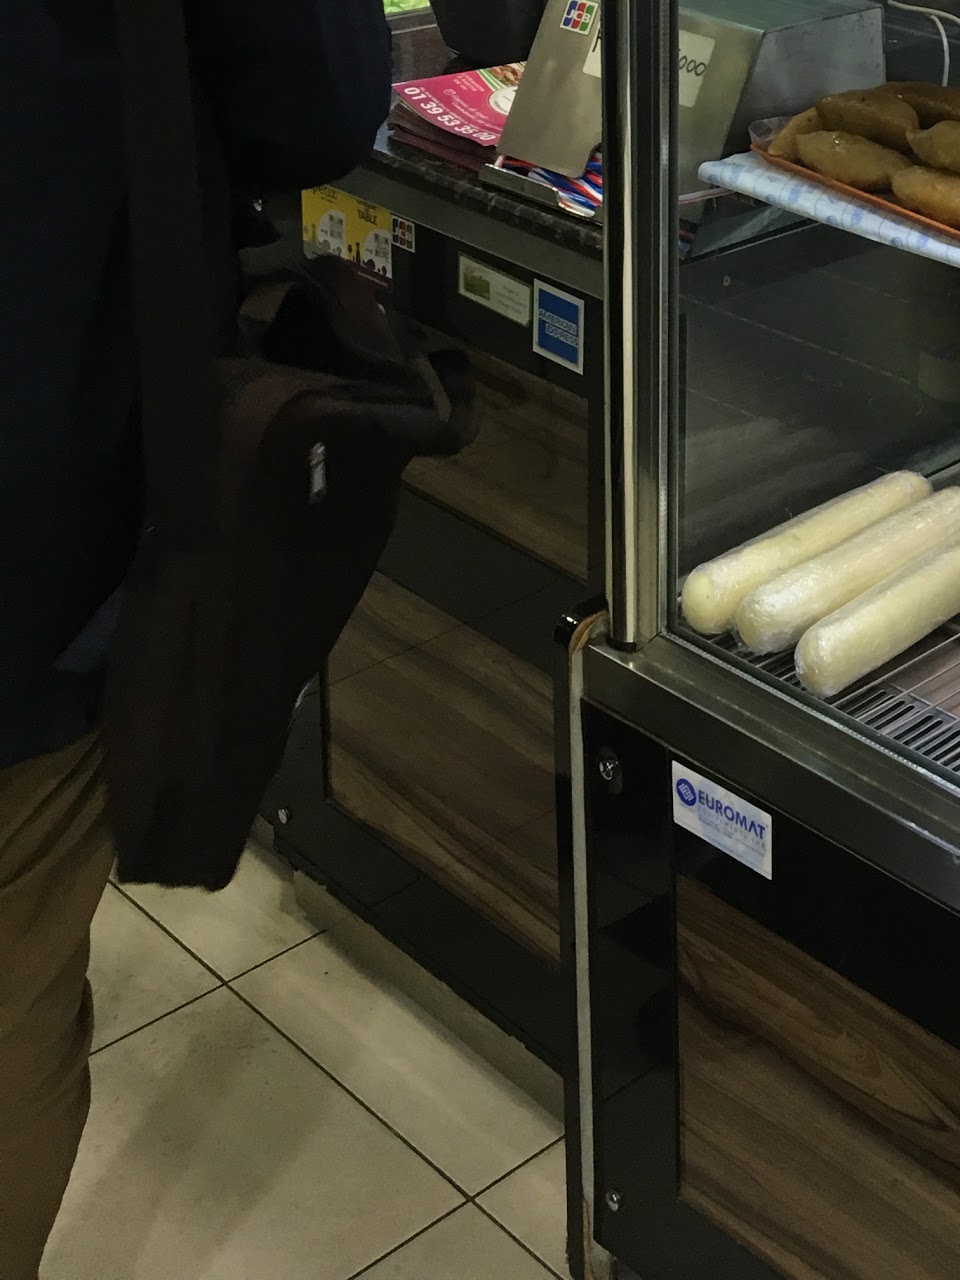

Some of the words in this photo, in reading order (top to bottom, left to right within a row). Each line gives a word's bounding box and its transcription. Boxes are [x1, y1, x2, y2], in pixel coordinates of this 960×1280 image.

[565, 8, 592, 24] JCB
[403, 86, 428, 101] 01
[420, 100, 444, 115] 39
[436, 114, 462, 127] 53
[453, 124, 479, 136] 35
[472, 131, 497, 141] 00
[357, 208, 378, 226] TABLE
[538, 308, 577, 336] AMERICAN
[546, 322, 579, 348] EXPRESS
[697, 789, 767, 841] EUROMAT
